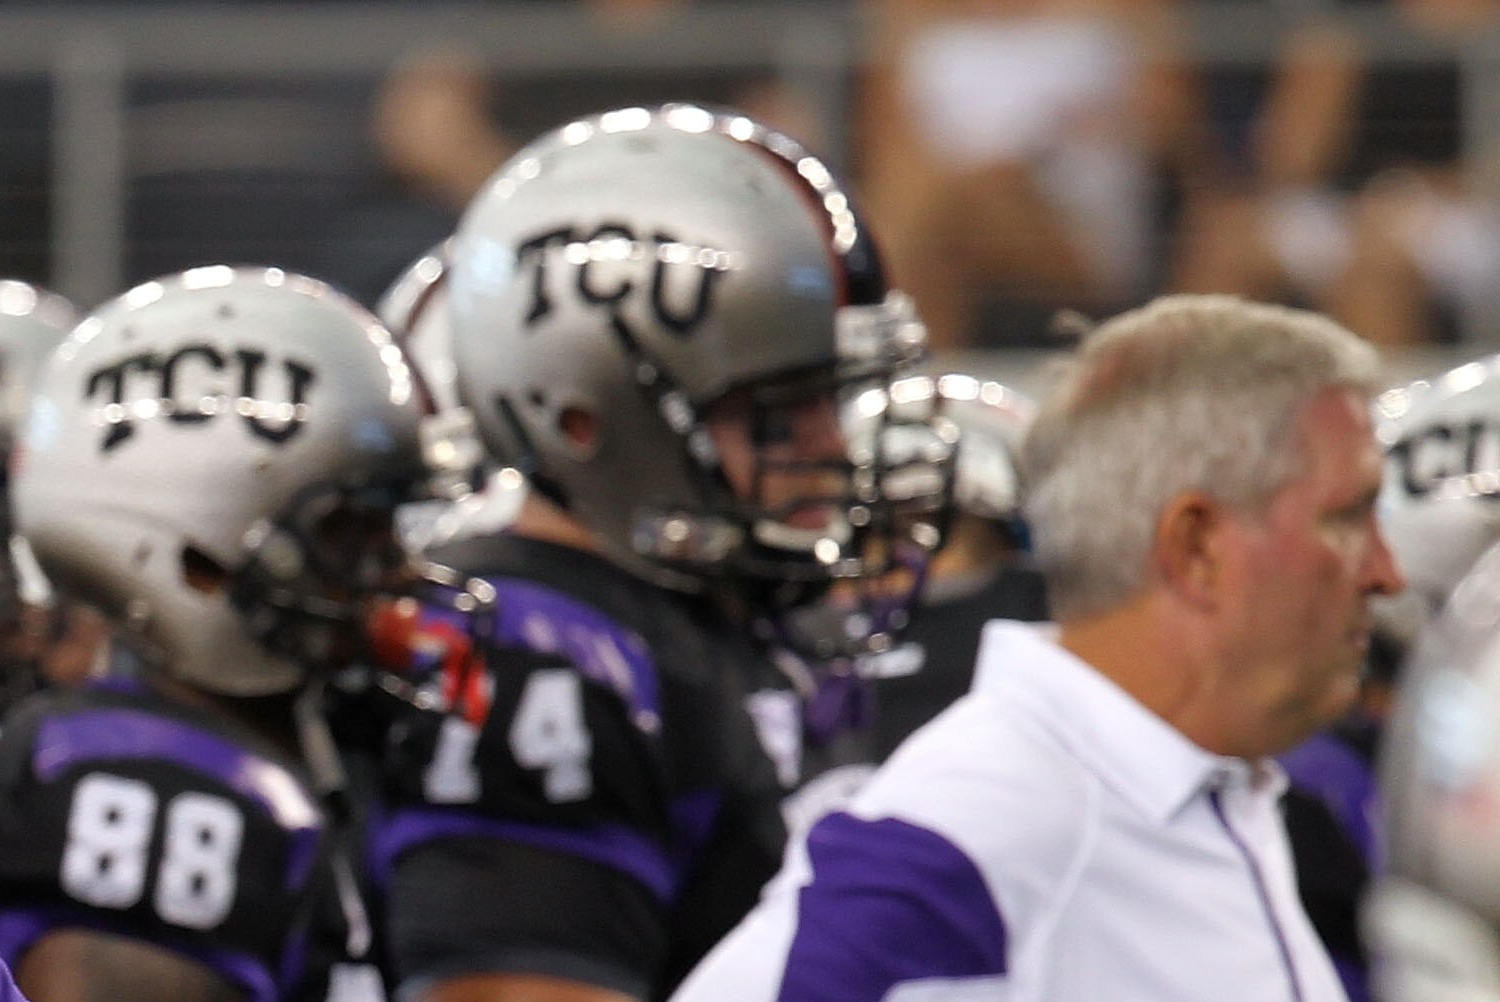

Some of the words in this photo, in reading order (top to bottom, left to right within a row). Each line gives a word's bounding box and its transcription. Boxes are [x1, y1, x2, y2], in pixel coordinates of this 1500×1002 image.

[517, 220, 730, 336] TCU
[86, 343, 318, 454] TCU
[60, 771, 244, 930] 88
